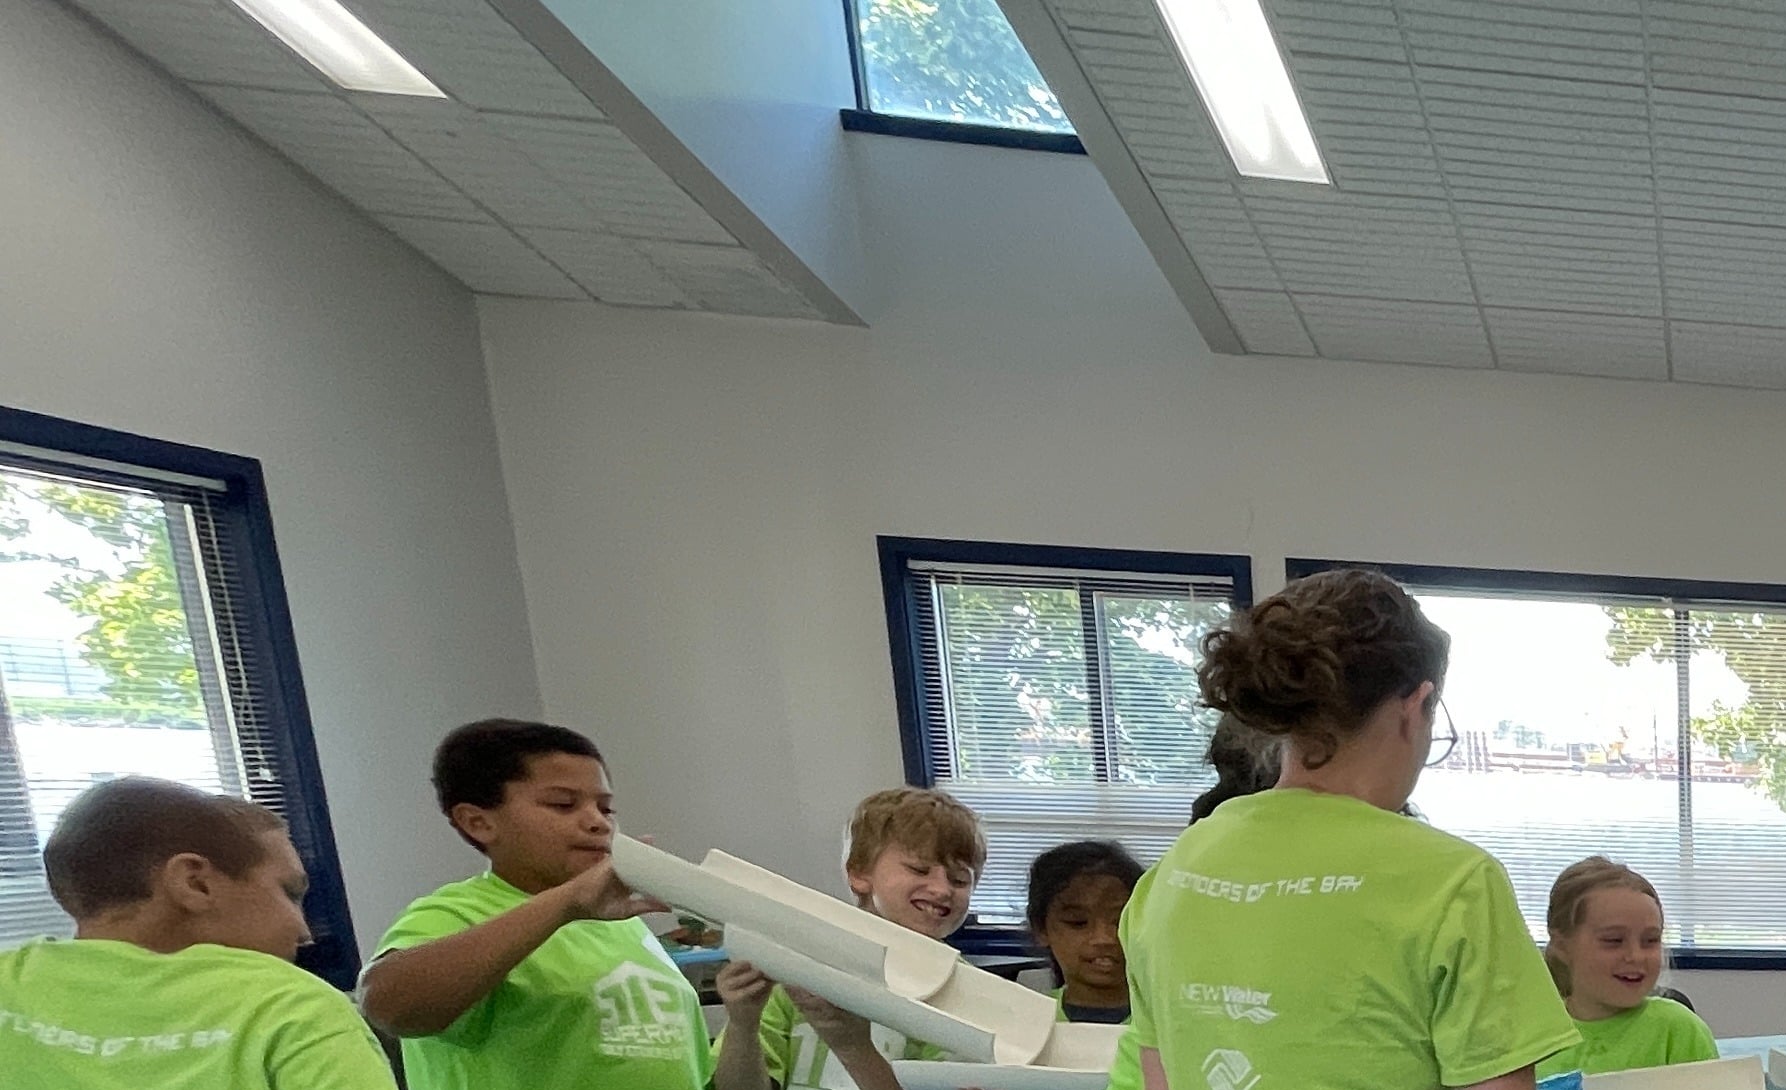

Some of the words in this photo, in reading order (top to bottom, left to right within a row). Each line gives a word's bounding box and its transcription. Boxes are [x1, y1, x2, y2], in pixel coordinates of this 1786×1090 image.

[1245, 882, 1274, 903] OF
[1276, 877, 1316, 897] THE
[1319, 875, 1364, 894] BAY
